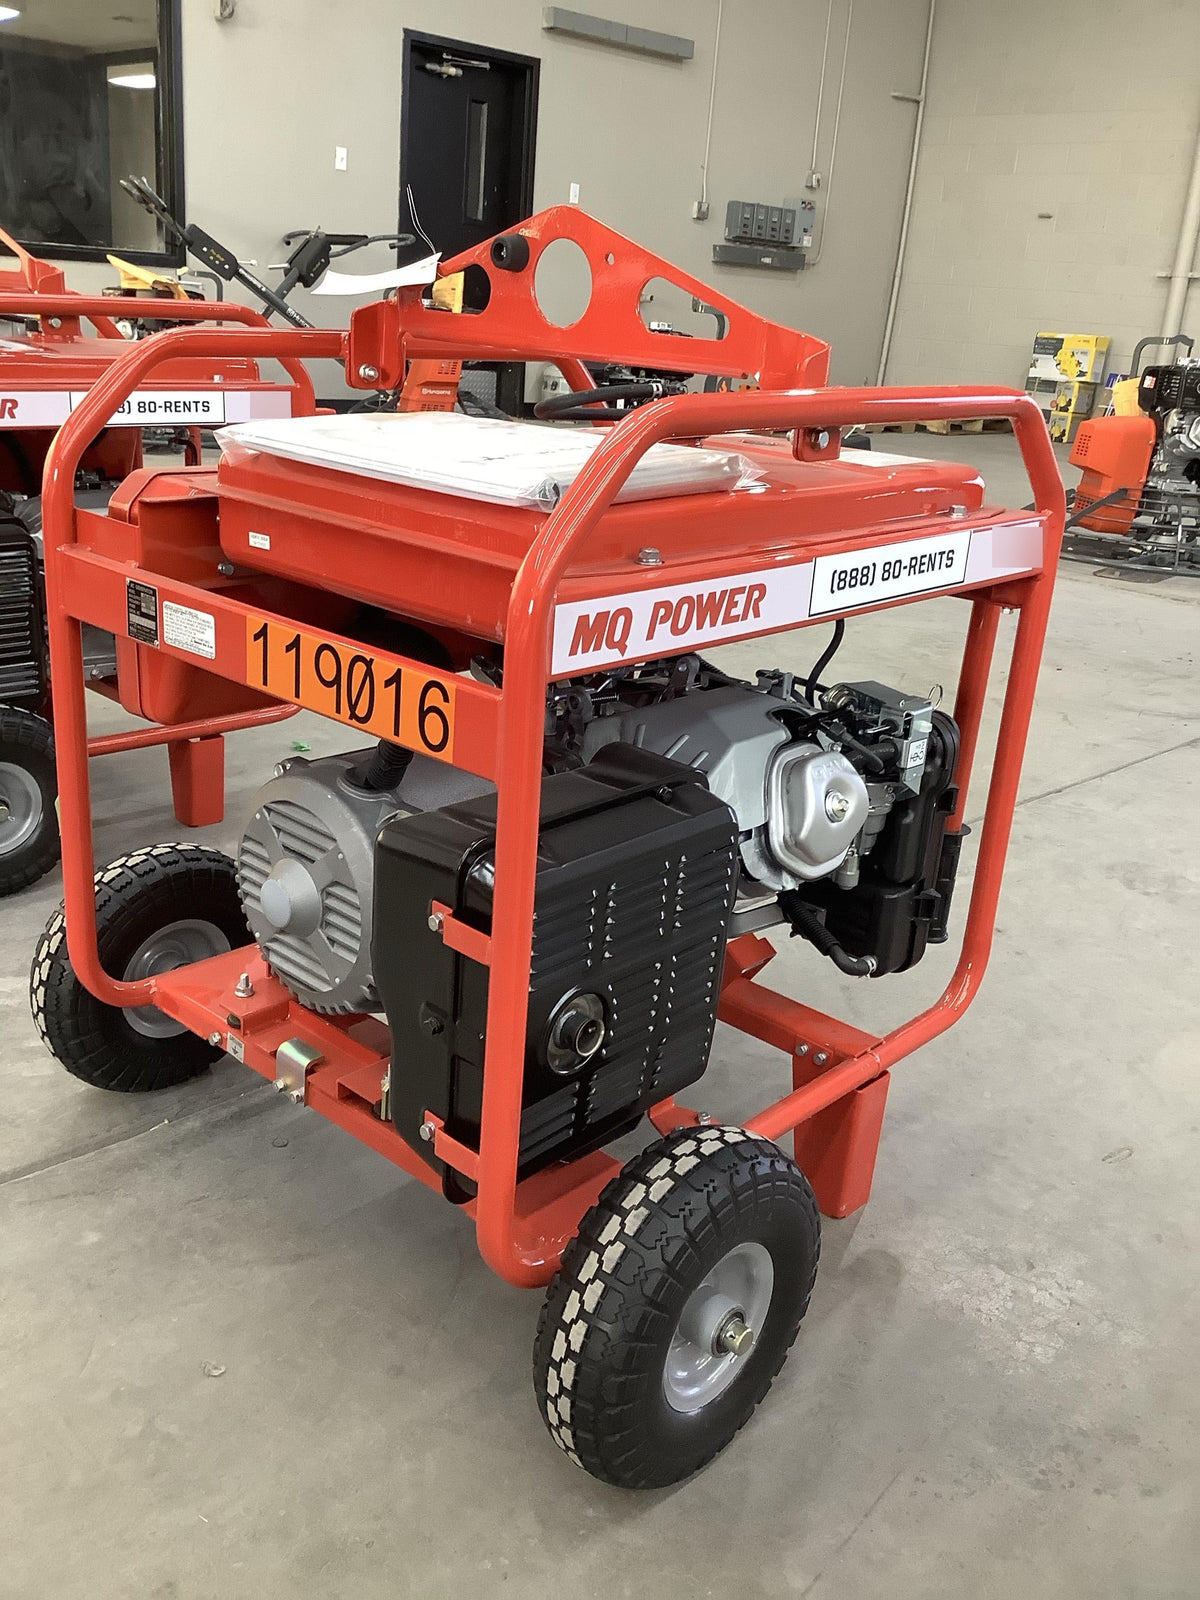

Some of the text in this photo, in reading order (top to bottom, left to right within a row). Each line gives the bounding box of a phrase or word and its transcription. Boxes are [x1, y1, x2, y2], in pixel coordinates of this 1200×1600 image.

[137, 400, 210, 413] 80-RENTS
[830, 549, 955, 594] (888) 80-RENTS
[568, 583, 767, 657] MQ POWER
